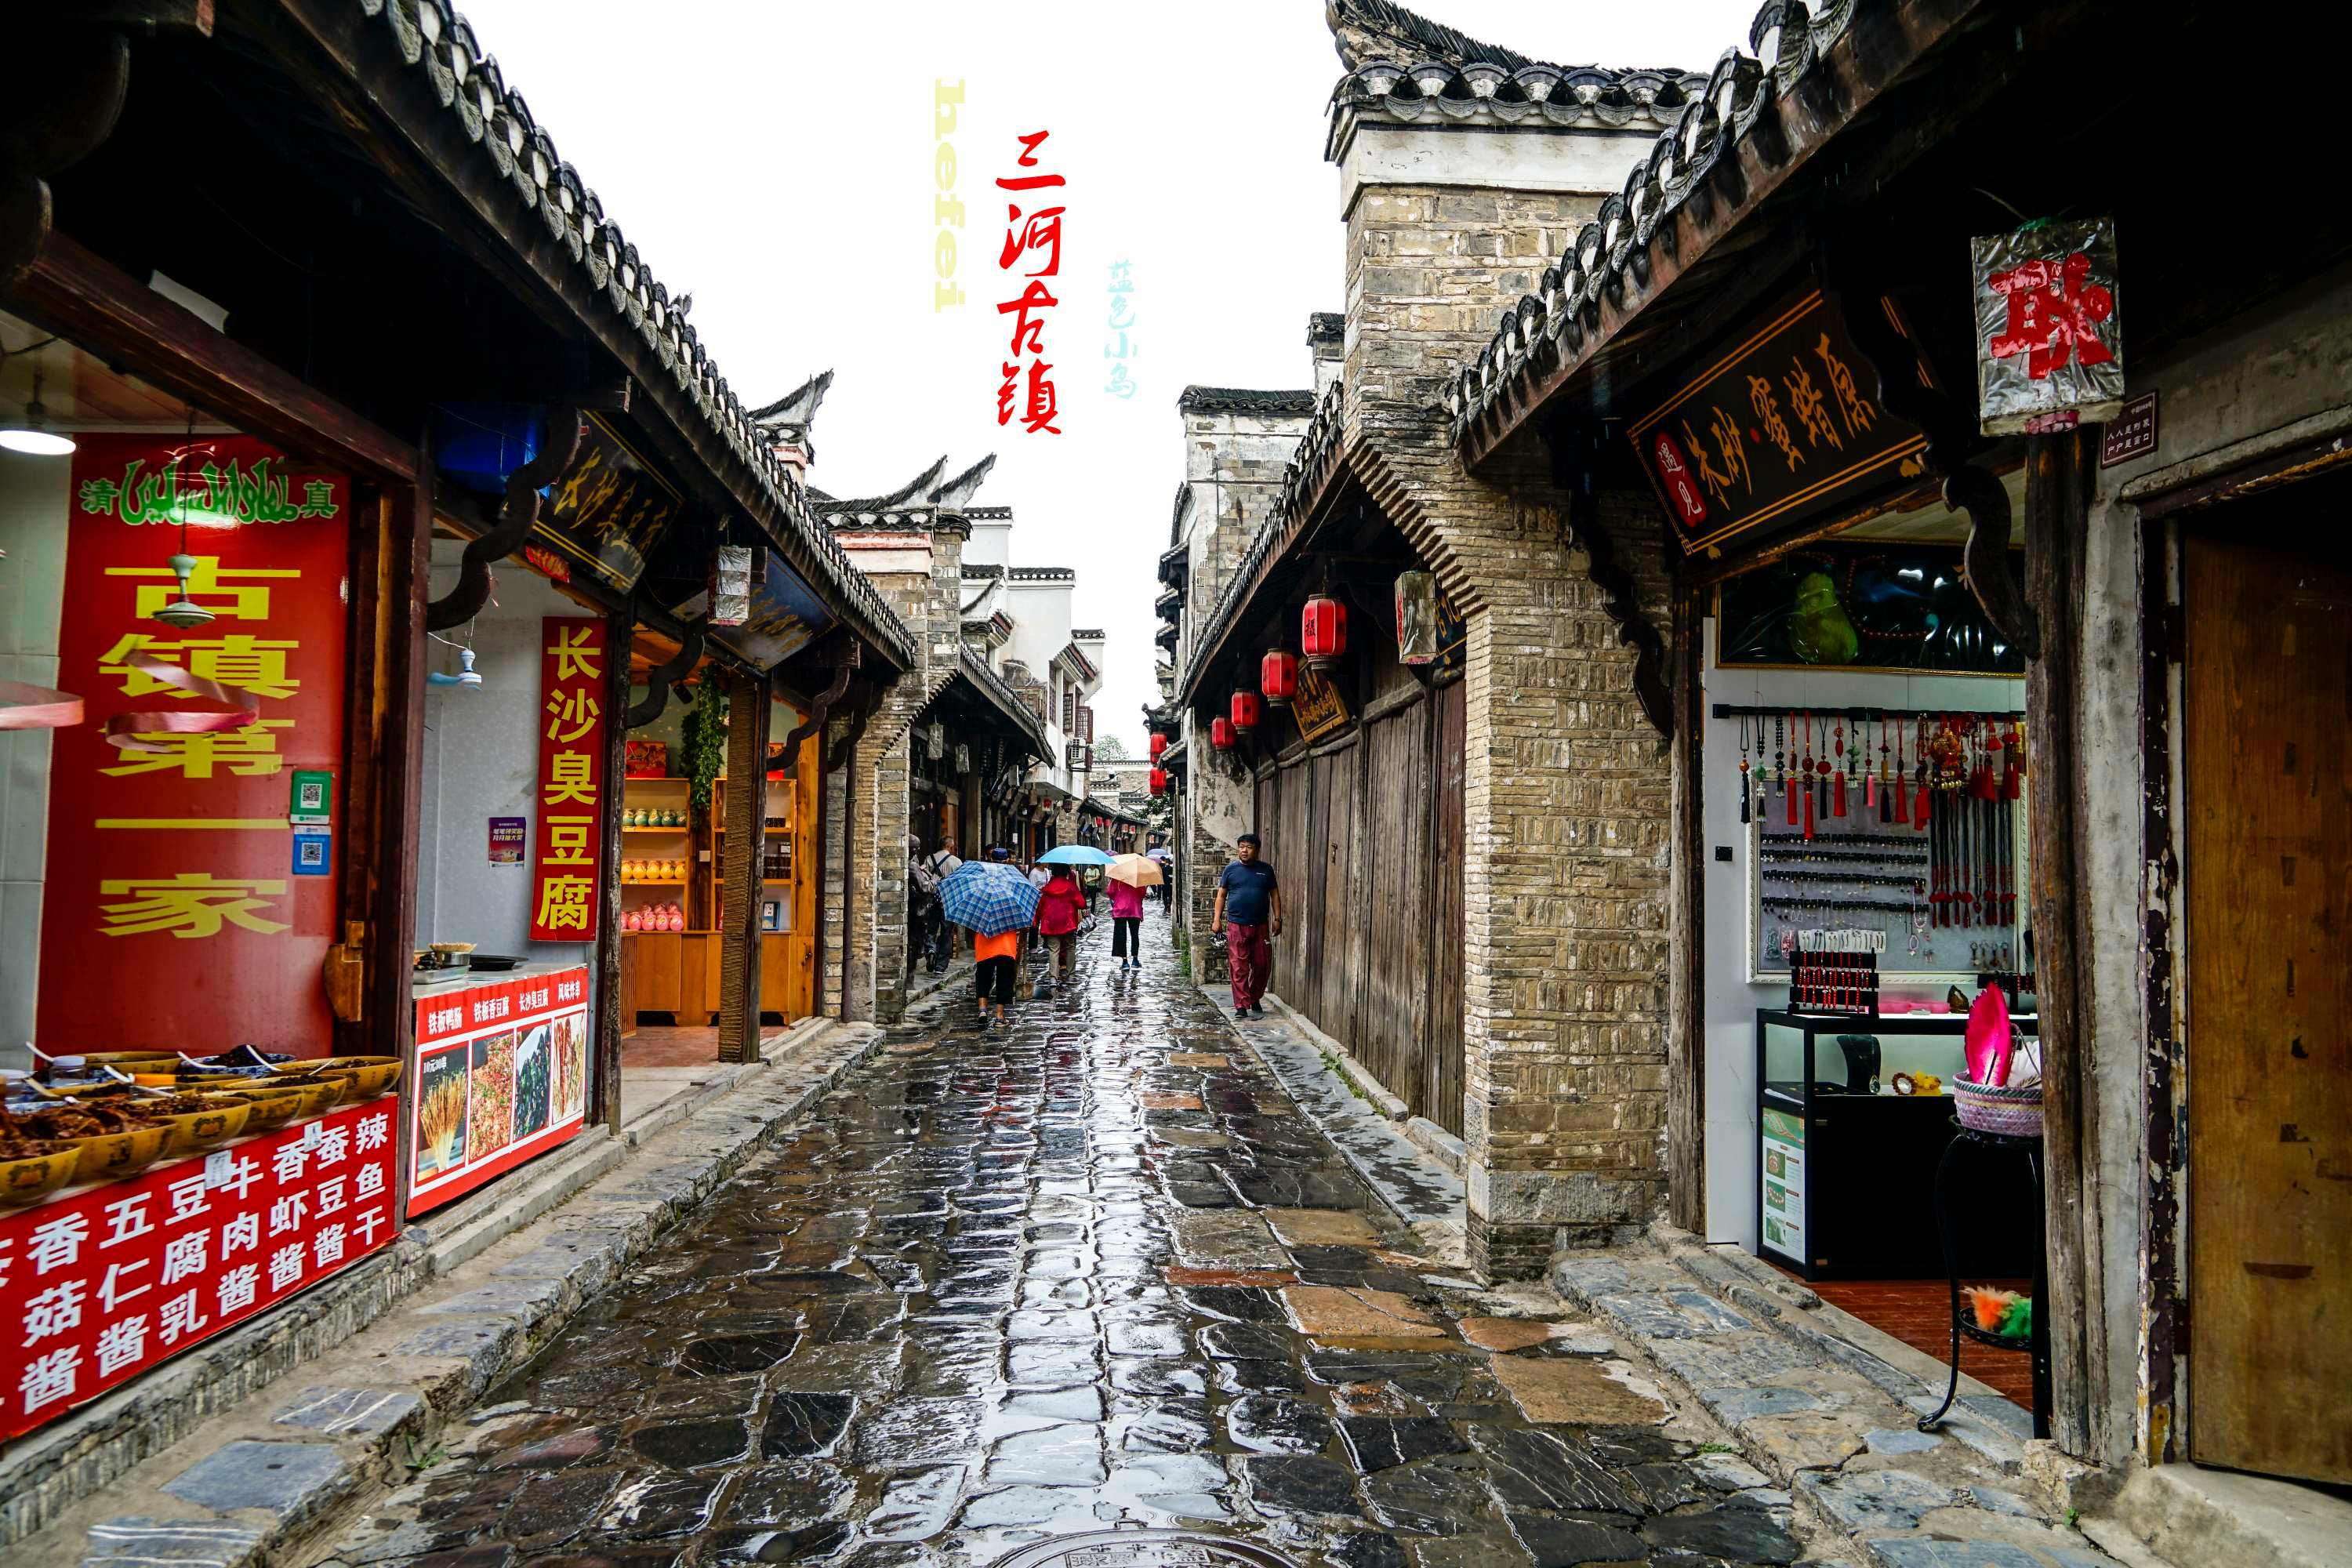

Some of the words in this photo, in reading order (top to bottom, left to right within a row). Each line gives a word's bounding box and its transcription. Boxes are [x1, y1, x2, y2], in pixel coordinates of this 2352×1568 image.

[79, 477, 119, 516] 清
[300, 479, 339, 519] 真
[95, 555, 302, 938] 古镇第一家
[536, 626, 602, 931] 长沙臭豆腐
[428, 1006, 463, 1036] 铁板鸭肠
[474, 996, 510, 1022] 铁板香豆腐
[518, 988, 549, 1012] 长沙臭豆腐
[158, 1173, 212, 1346] 豆腐乳
[216, 1156, 264, 1318] 牛肉酱
[268, 1138, 312, 1292] 香虾酱
[313, 1123, 350, 1269] 蚕豆酱
[352, 1110, 390, 1247] 辣鱼干
[18, 1211, 89, 1415] 香菇酱
[94, 1191, 155, 1379] 五仁酱
